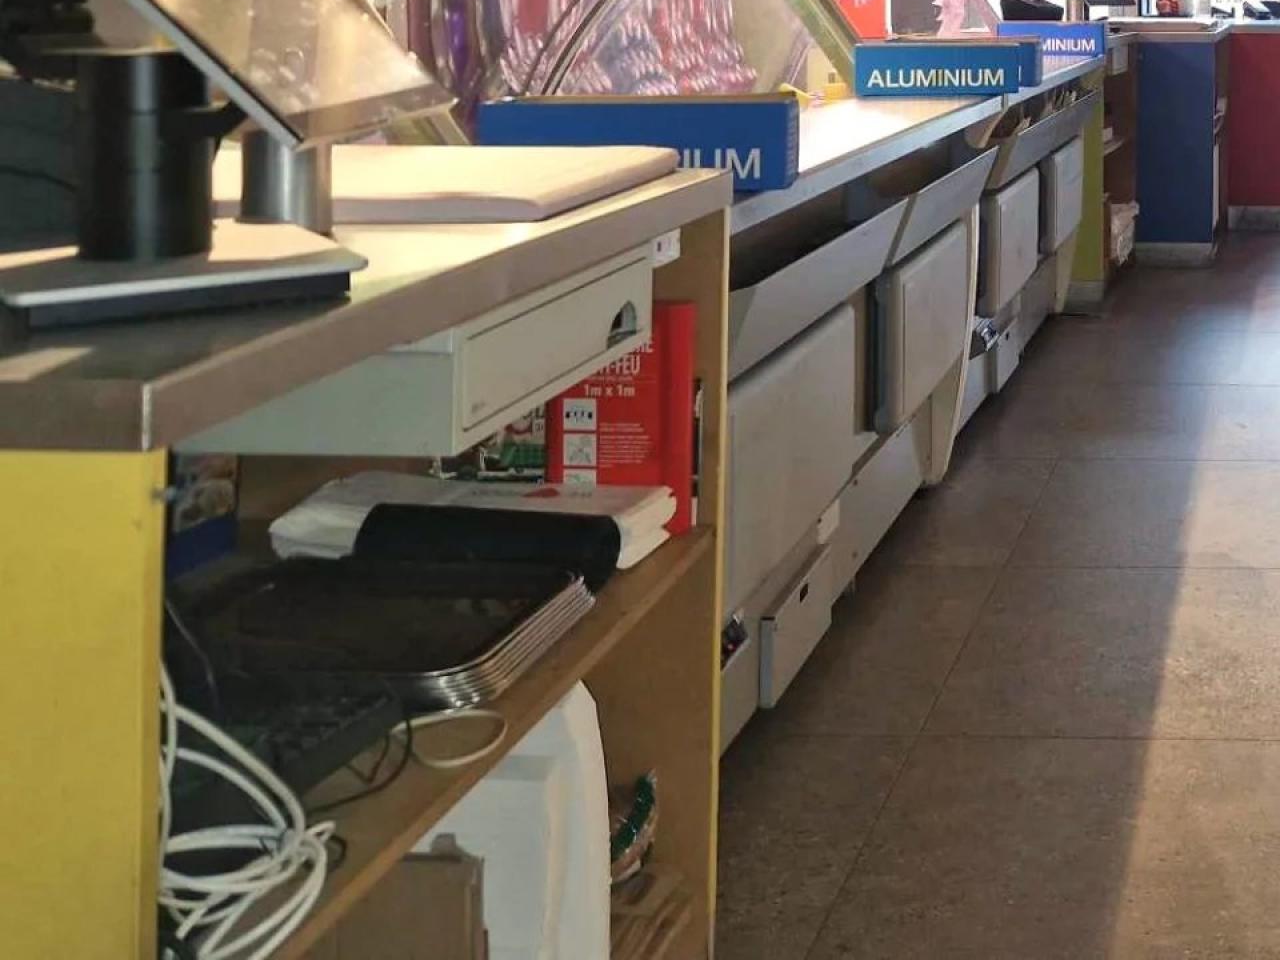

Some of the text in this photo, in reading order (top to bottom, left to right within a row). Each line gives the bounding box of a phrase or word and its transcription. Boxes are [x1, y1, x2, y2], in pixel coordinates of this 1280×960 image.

[1041, 38, 1096, 52] MINIUM
[867, 69, 1004, 88] ALUMINIUM
[617, 384, 636, 397] 1m
